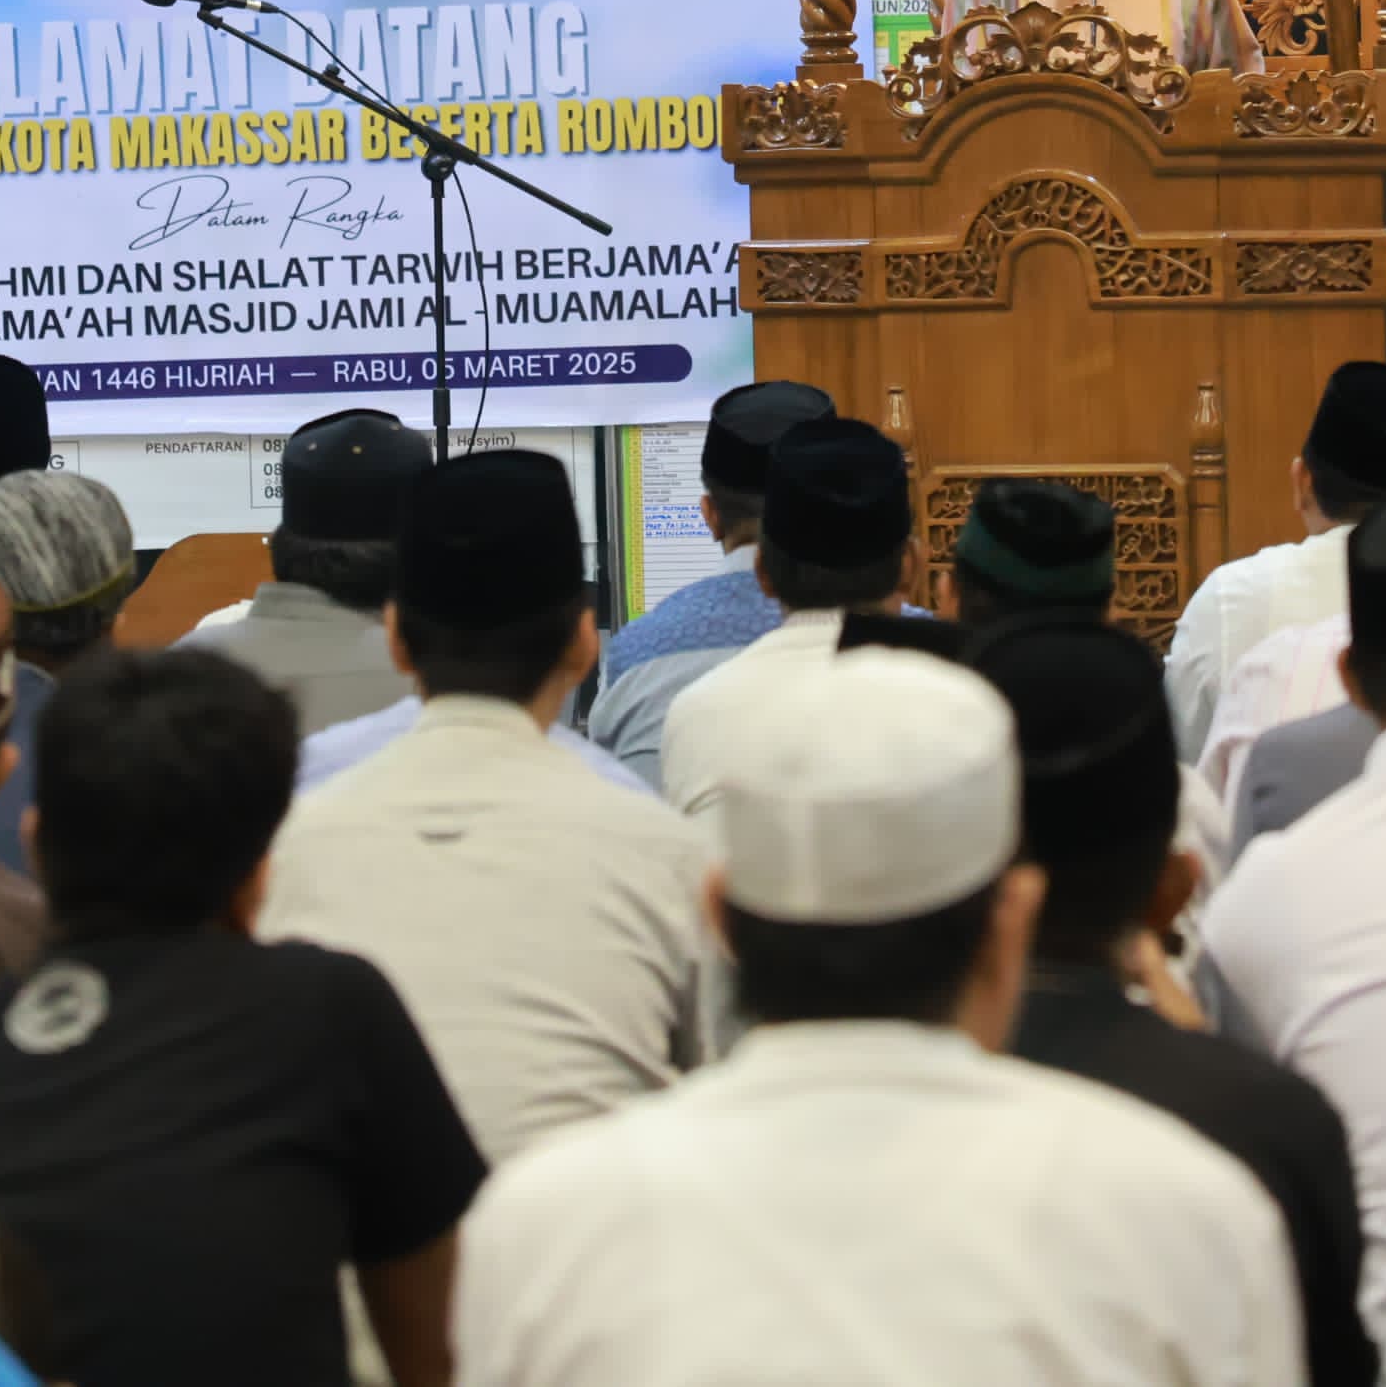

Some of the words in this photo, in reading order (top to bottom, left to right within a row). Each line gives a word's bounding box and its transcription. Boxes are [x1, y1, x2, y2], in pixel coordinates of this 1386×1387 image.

[286, 1, 590, 106] DATANG
[109, 108, 348, 170] MAKASSAR
[360, 101, 545, 162] BESERTA
[557, 94, 723, 155] ROMBO
[280, 174, 404, 249] Rangka
[77, 260, 163, 295] DAN
[172, 255, 334, 293] SHALAT
[341, 248, 505, 286] TARWIH
[514, 240, 740, 280] BERJAMA'A
[144, 300, 297, 336] MASJID
[307, 296, 406, 332] JAMI
[414, 295, 467, 327] AL
[495, 285, 738, 325] MUAMALAH
[90, 366, 157, 391] 1446
[164, 362, 275, 389] HIJRIAH
[333, 359, 412, 384] RABU,
[421, 357, 455, 381] 05
[464, 354, 560, 378] MARET
[569, 351, 637, 376] 2025
